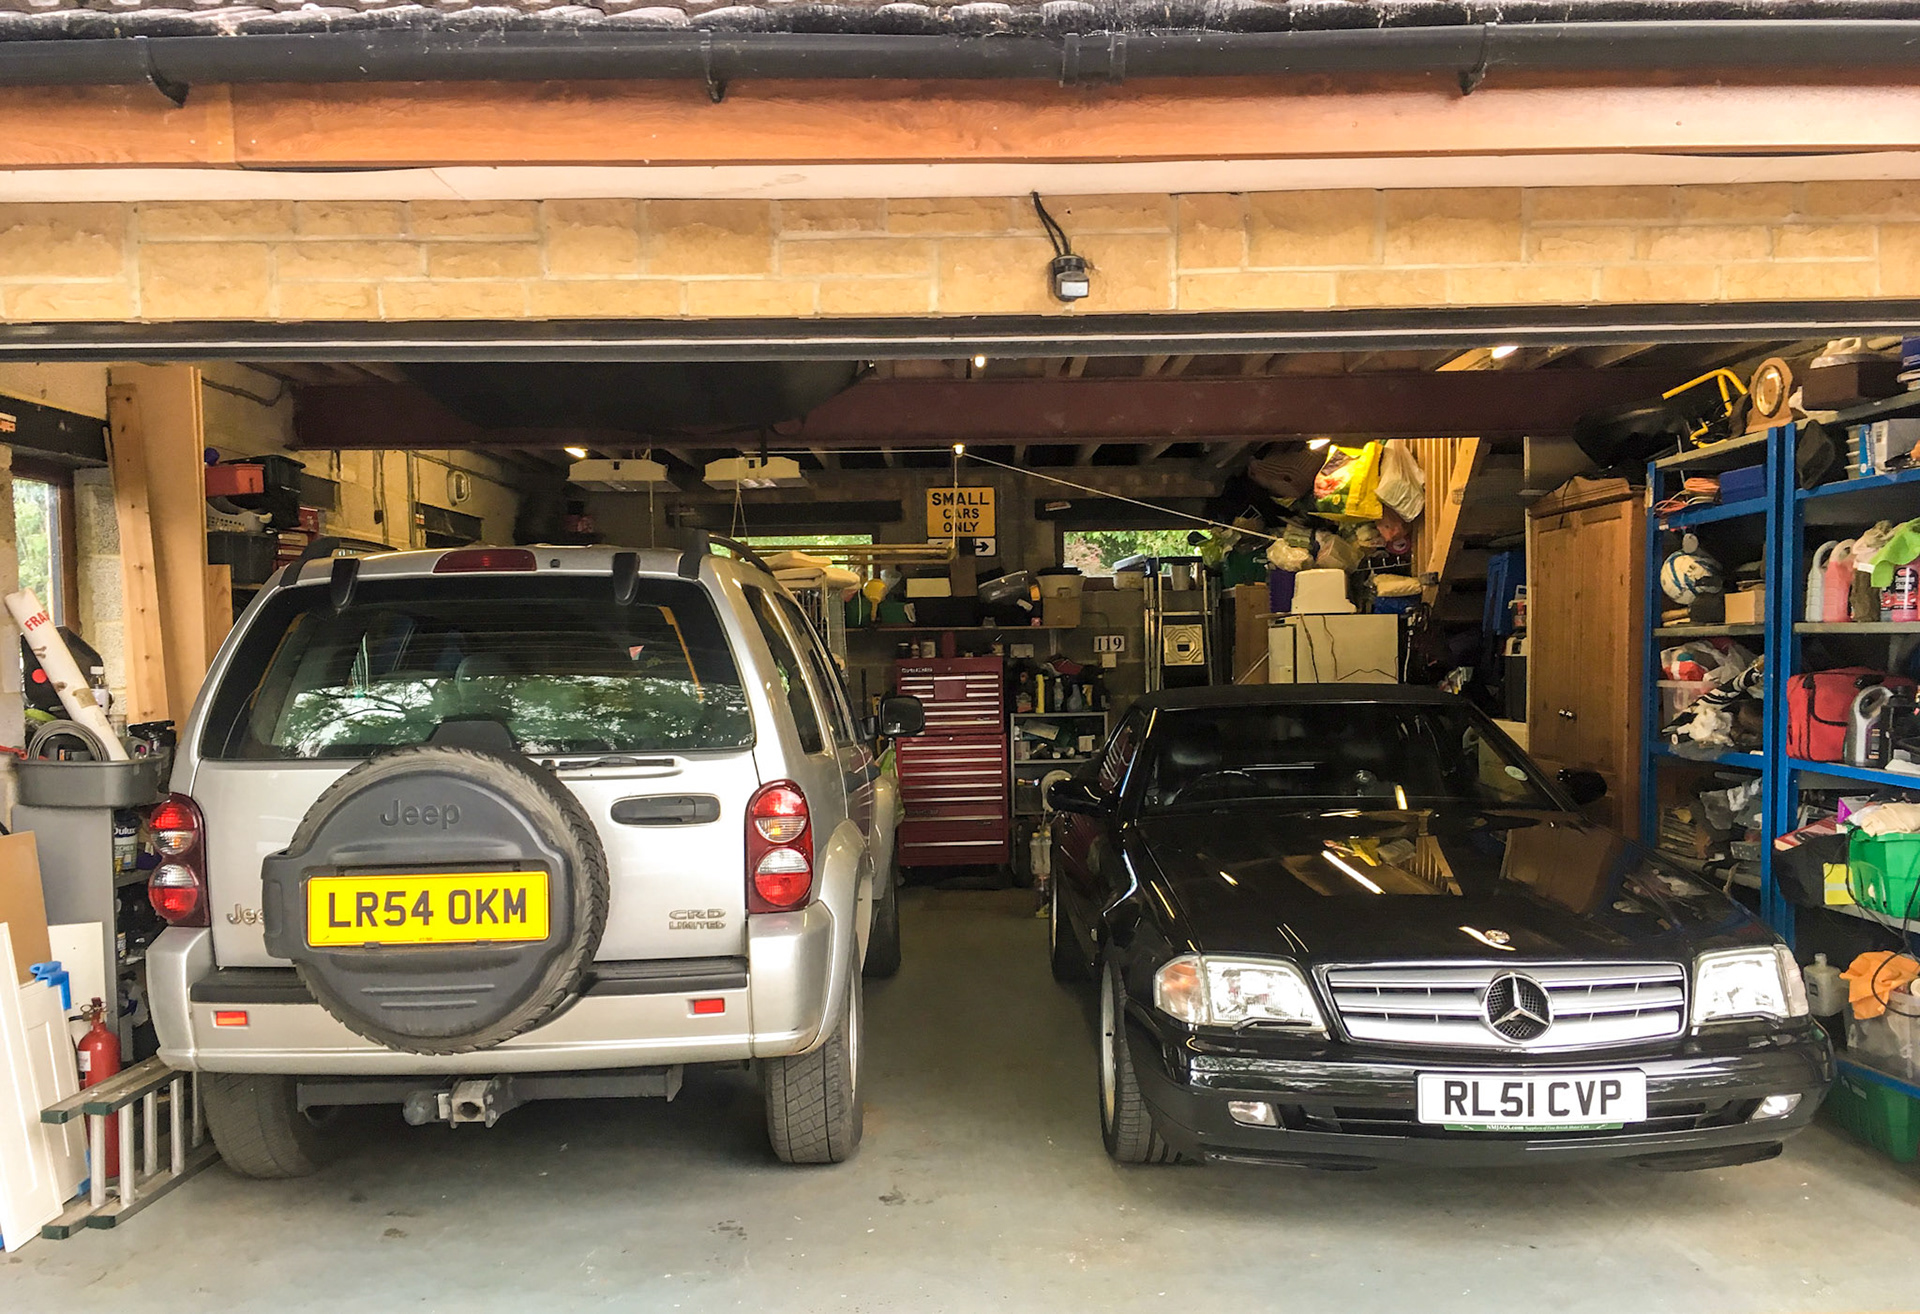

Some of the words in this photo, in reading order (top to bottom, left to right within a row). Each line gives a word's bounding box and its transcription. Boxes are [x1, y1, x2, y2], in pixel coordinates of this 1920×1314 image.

[932, 492, 990, 506] SMALL
[943, 508, 979, 519] CARS
[943, 522, 979, 533] ONLY
[1098, 637, 1122, 650] 119
[380, 799, 460, 830] Jeep
[328, 890, 434, 928] LR54
[448, 888, 527, 925] OKM
[669, 909, 726, 920] CRD
[669, 920, 726, 930] LIMITED
[1444, 1080, 1535, 1117] RL51
[1548, 1079, 1622, 1116] CVP
